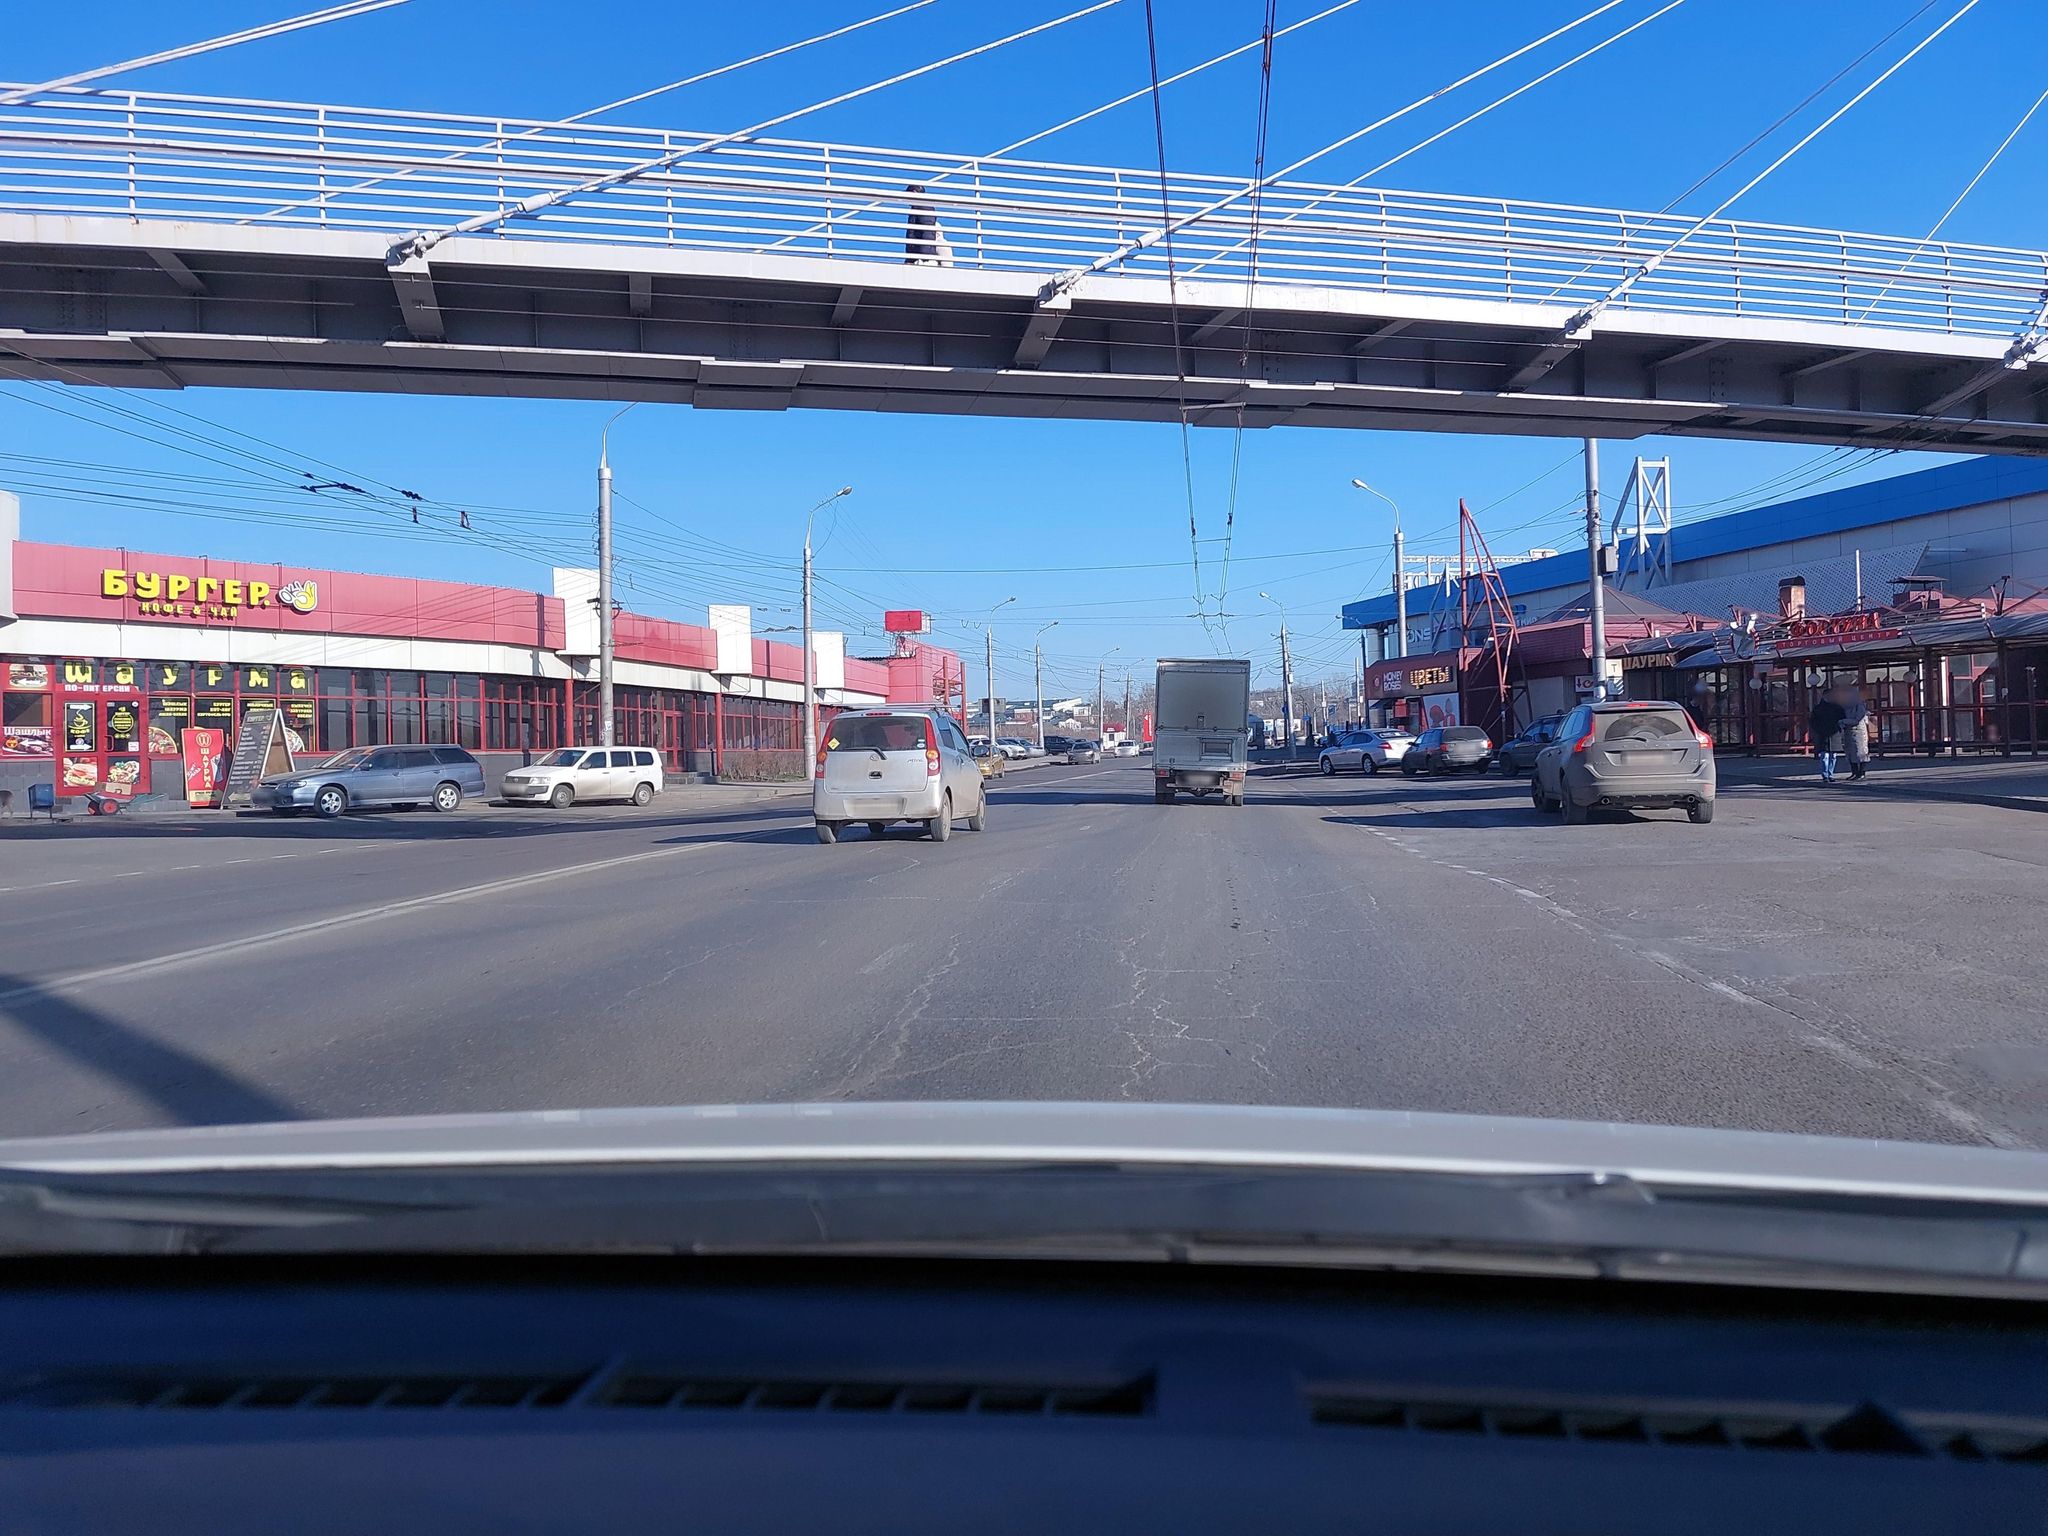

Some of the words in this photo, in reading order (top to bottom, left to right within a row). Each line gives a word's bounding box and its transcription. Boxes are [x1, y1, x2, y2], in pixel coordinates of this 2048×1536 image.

[141, 602, 184, 615] КОФЕ
[193, 605, 201, 615] &
[210, 606, 238, 617] ЧАЙ
[1782, 637, 1842, 648] ТОРГОВЫЙ
[1851, 632, 1890, 641] ЦЕНТР
[1410, 666, 1449, 689] ЦВЕТЫ
[4, 727, 52, 736] Шашлык
[200, 748, 212, 788] ШАУРМА
